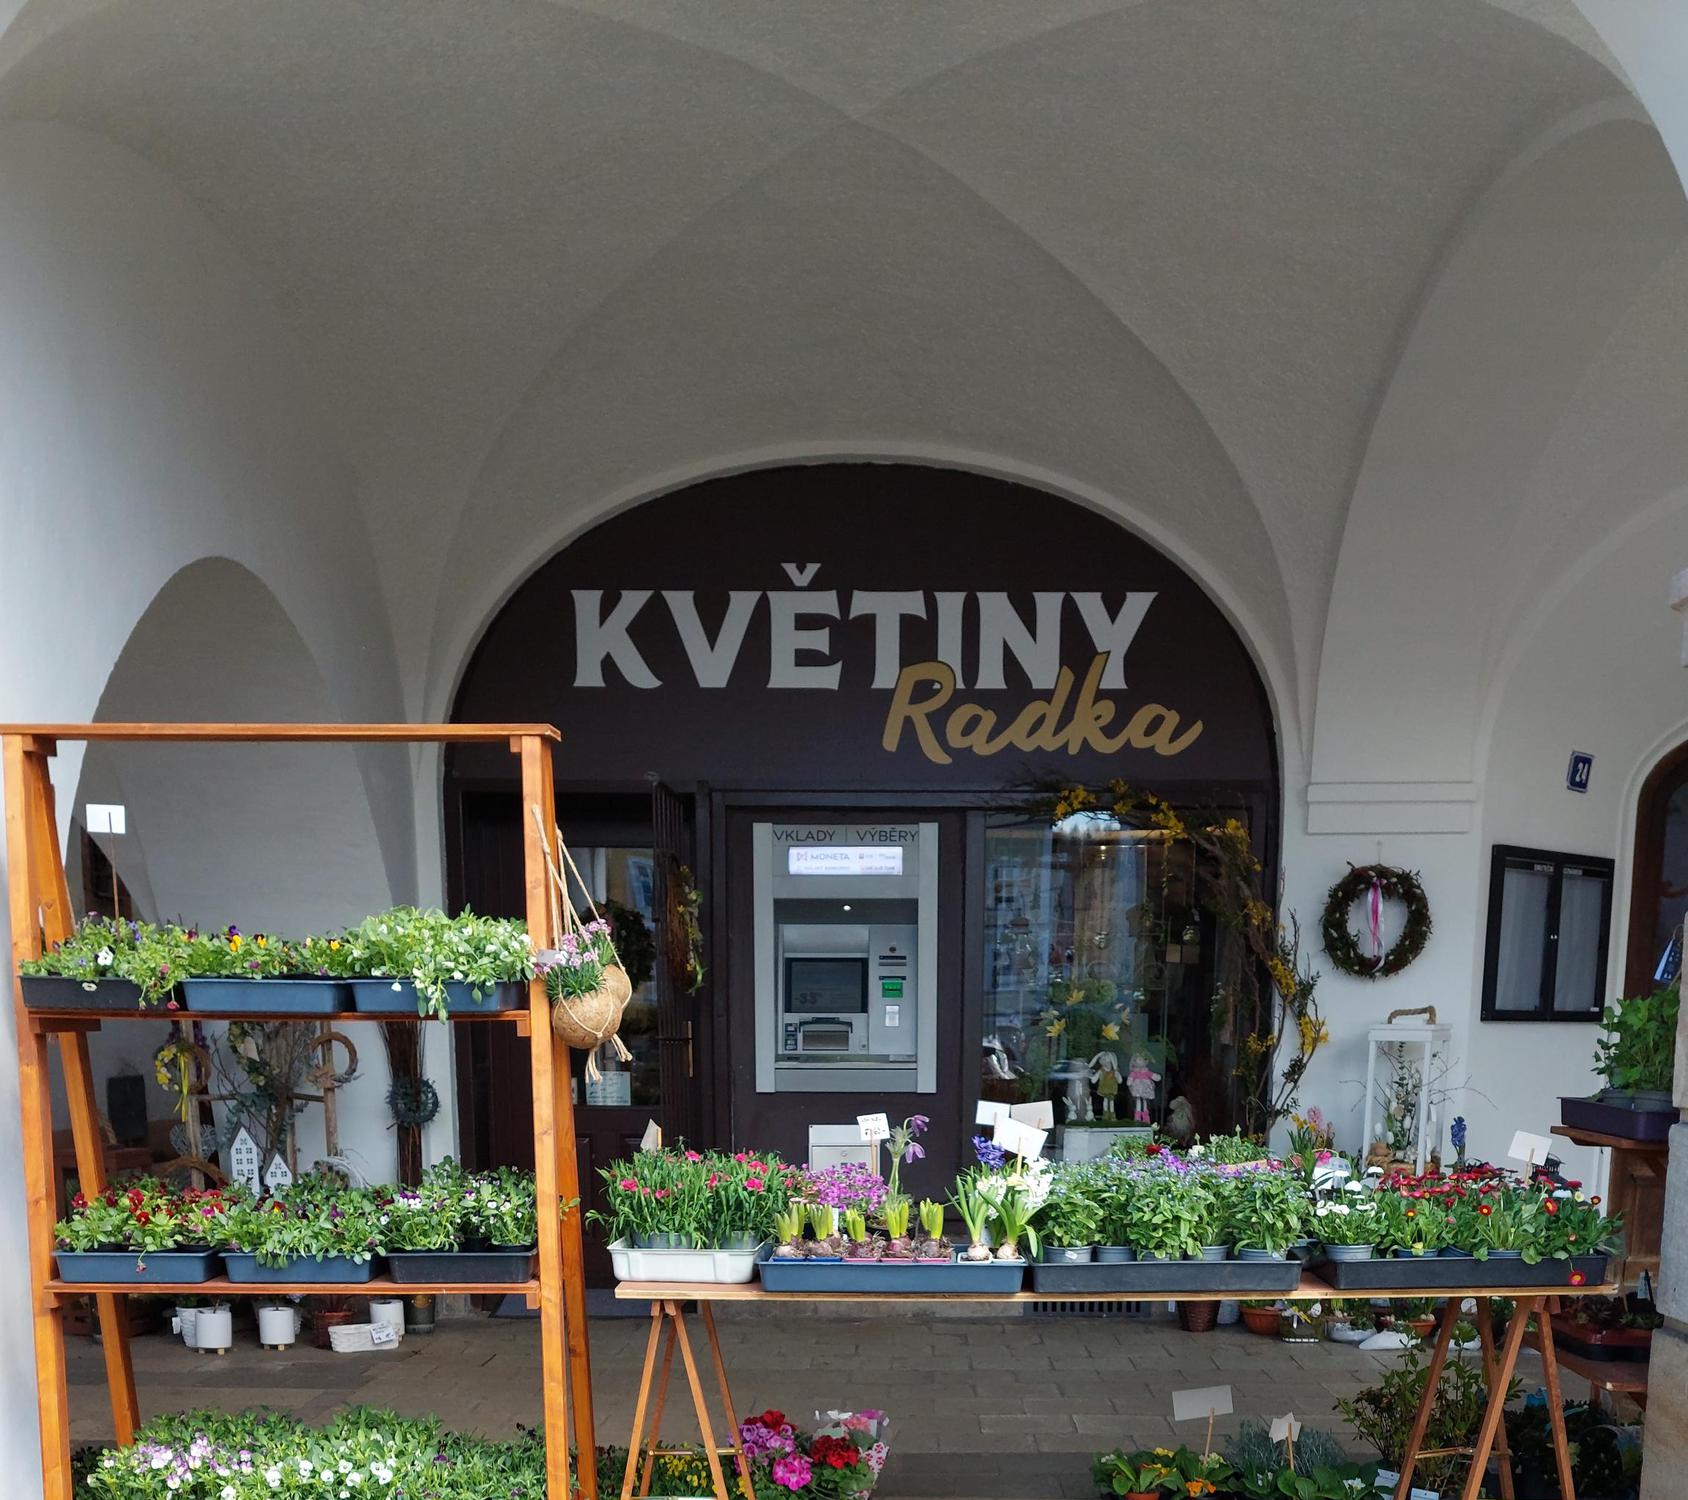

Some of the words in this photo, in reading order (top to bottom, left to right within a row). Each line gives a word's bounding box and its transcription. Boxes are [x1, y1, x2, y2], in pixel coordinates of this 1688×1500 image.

[571, 562, 1158, 690] KVĚTINY
[882, 651, 1204, 765] Radka
[773, 829, 836, 843] VKLADY
[856, 827, 919, 843] VÝBĚRY
